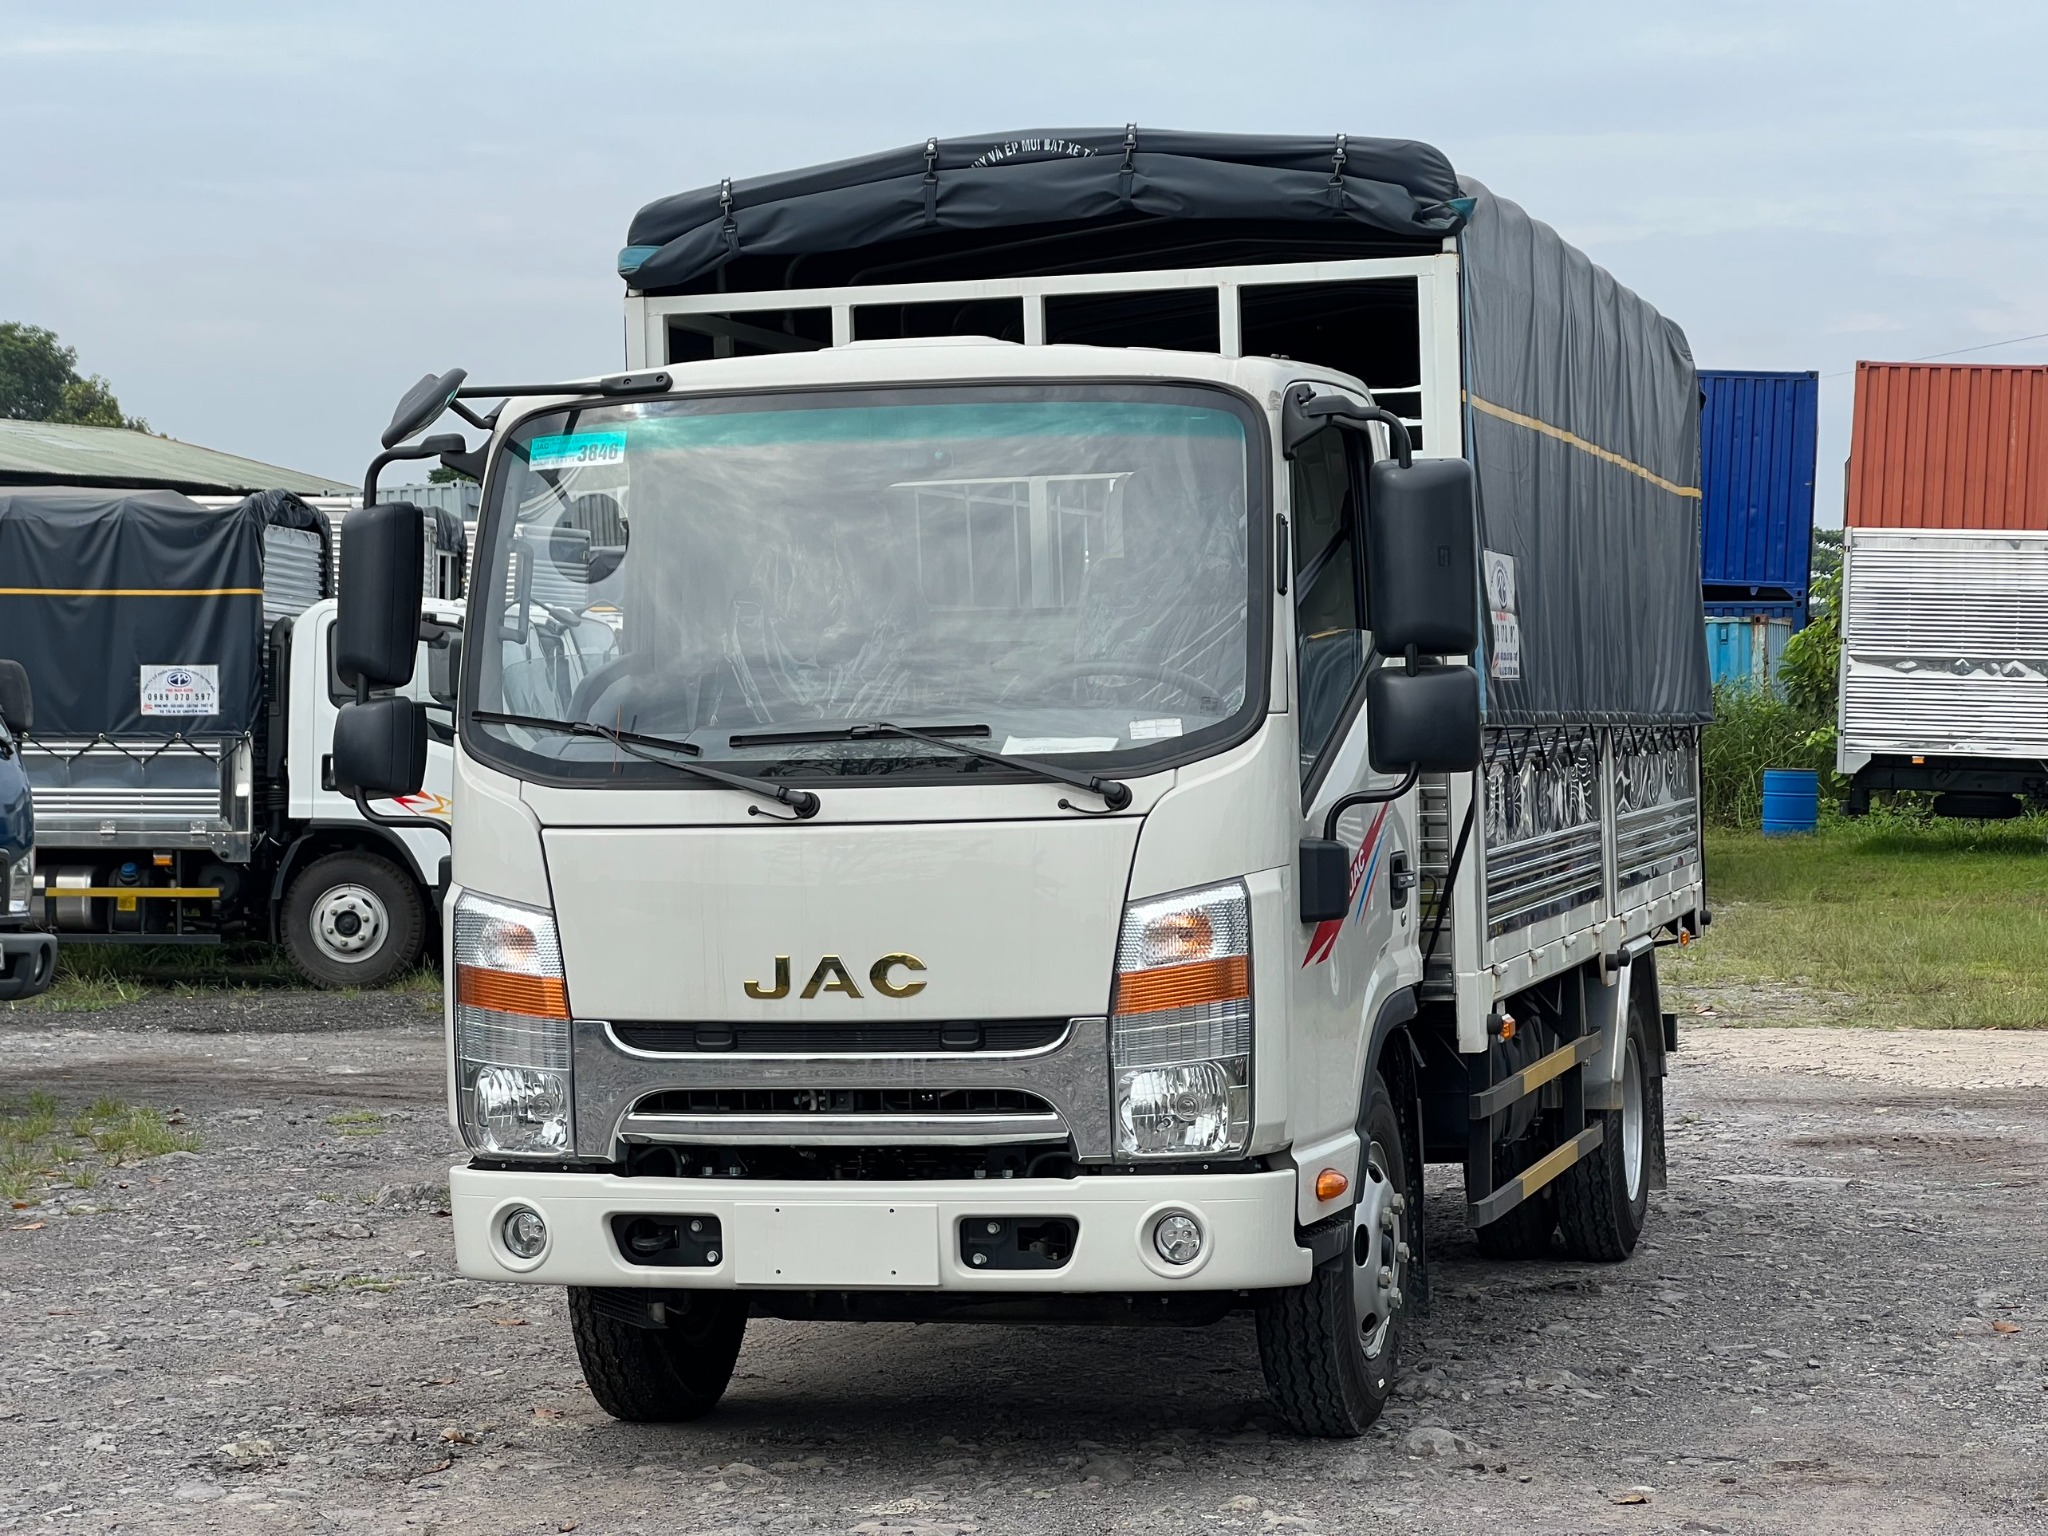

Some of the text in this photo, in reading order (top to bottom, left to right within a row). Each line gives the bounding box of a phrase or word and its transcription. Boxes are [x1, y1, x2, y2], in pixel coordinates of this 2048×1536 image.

[988, 146, 1004, 162] VÀ
[1005, 140, 1019, 157] ÉP
[1021, 138, 1040, 152] MUI
[1066, 142, 1081, 156] XE
[577, 443, 619, 462] 3846
[174, 693, 190, 701] 070
[195, 693, 211, 701] 597
[1349, 849, 1365, 896] JAC
[743, 952, 928, 999] JAC
